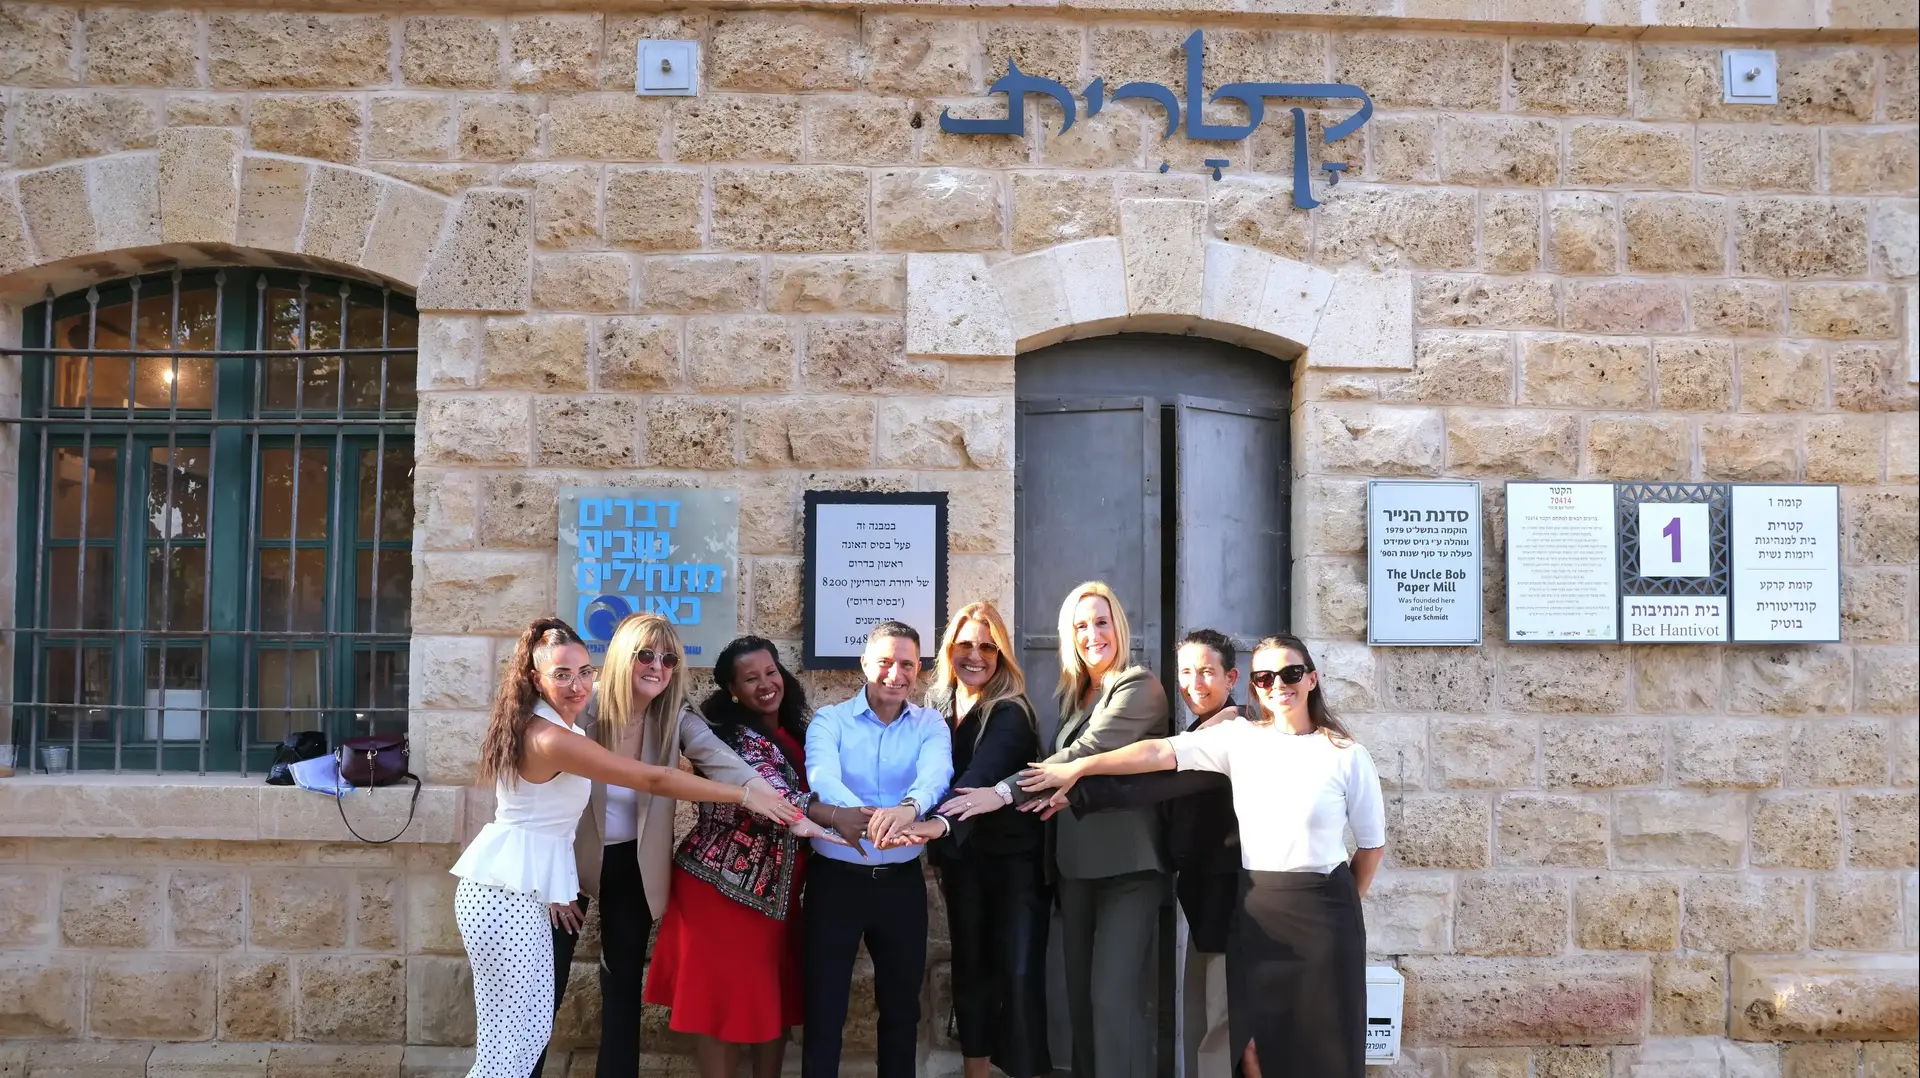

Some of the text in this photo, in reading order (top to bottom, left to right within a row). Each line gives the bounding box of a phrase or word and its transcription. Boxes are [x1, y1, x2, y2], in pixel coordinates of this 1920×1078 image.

[1550, 487, 1572, 495] הקטר
[1769, 498, 1802, 509] קומה 1
[579, 498, 682, 527] דברים
[1383, 510, 1469, 522] סדנת הנייר
[1441, 528, 1467, 536] הוקמה
[1768, 521, 1803, 536] קטרית
[578, 530, 670, 559] טובים
[894, 539, 911, 550] פעל
[1444, 537, 1469, 545] ונוהלה
[1663, 517, 1682, 563] 1
[1755, 535, 1817, 545] בית למנהיגות
[1422, 550, 1435, 559] סוף
[1450, 549, 1472, 557] פעלה
[1759, 550, 1814, 559] ויזמות נשית
[849, 560, 903, 570] ראשון בדרום
[577, 560, 722, 593] מתחילים
[1387, 569, 1466, 579] The Uncle Bob
[822, 577, 929, 588] של יחידת המודיעין 8200
[1397, 582, 1456, 594] Paper Mill
[1760, 581, 1813, 592] קומת קרקע
[1435, 605, 1442, 613] by
[1631, 604, 1720, 617] בית הנתיבות
[1756, 601, 1817, 614] קונדיטורית
[856, 617, 881, 625] השנים
[1771, 619, 1803, 631] בוטיק
[1632, 623, 1719, 636] Bet Hantivot
